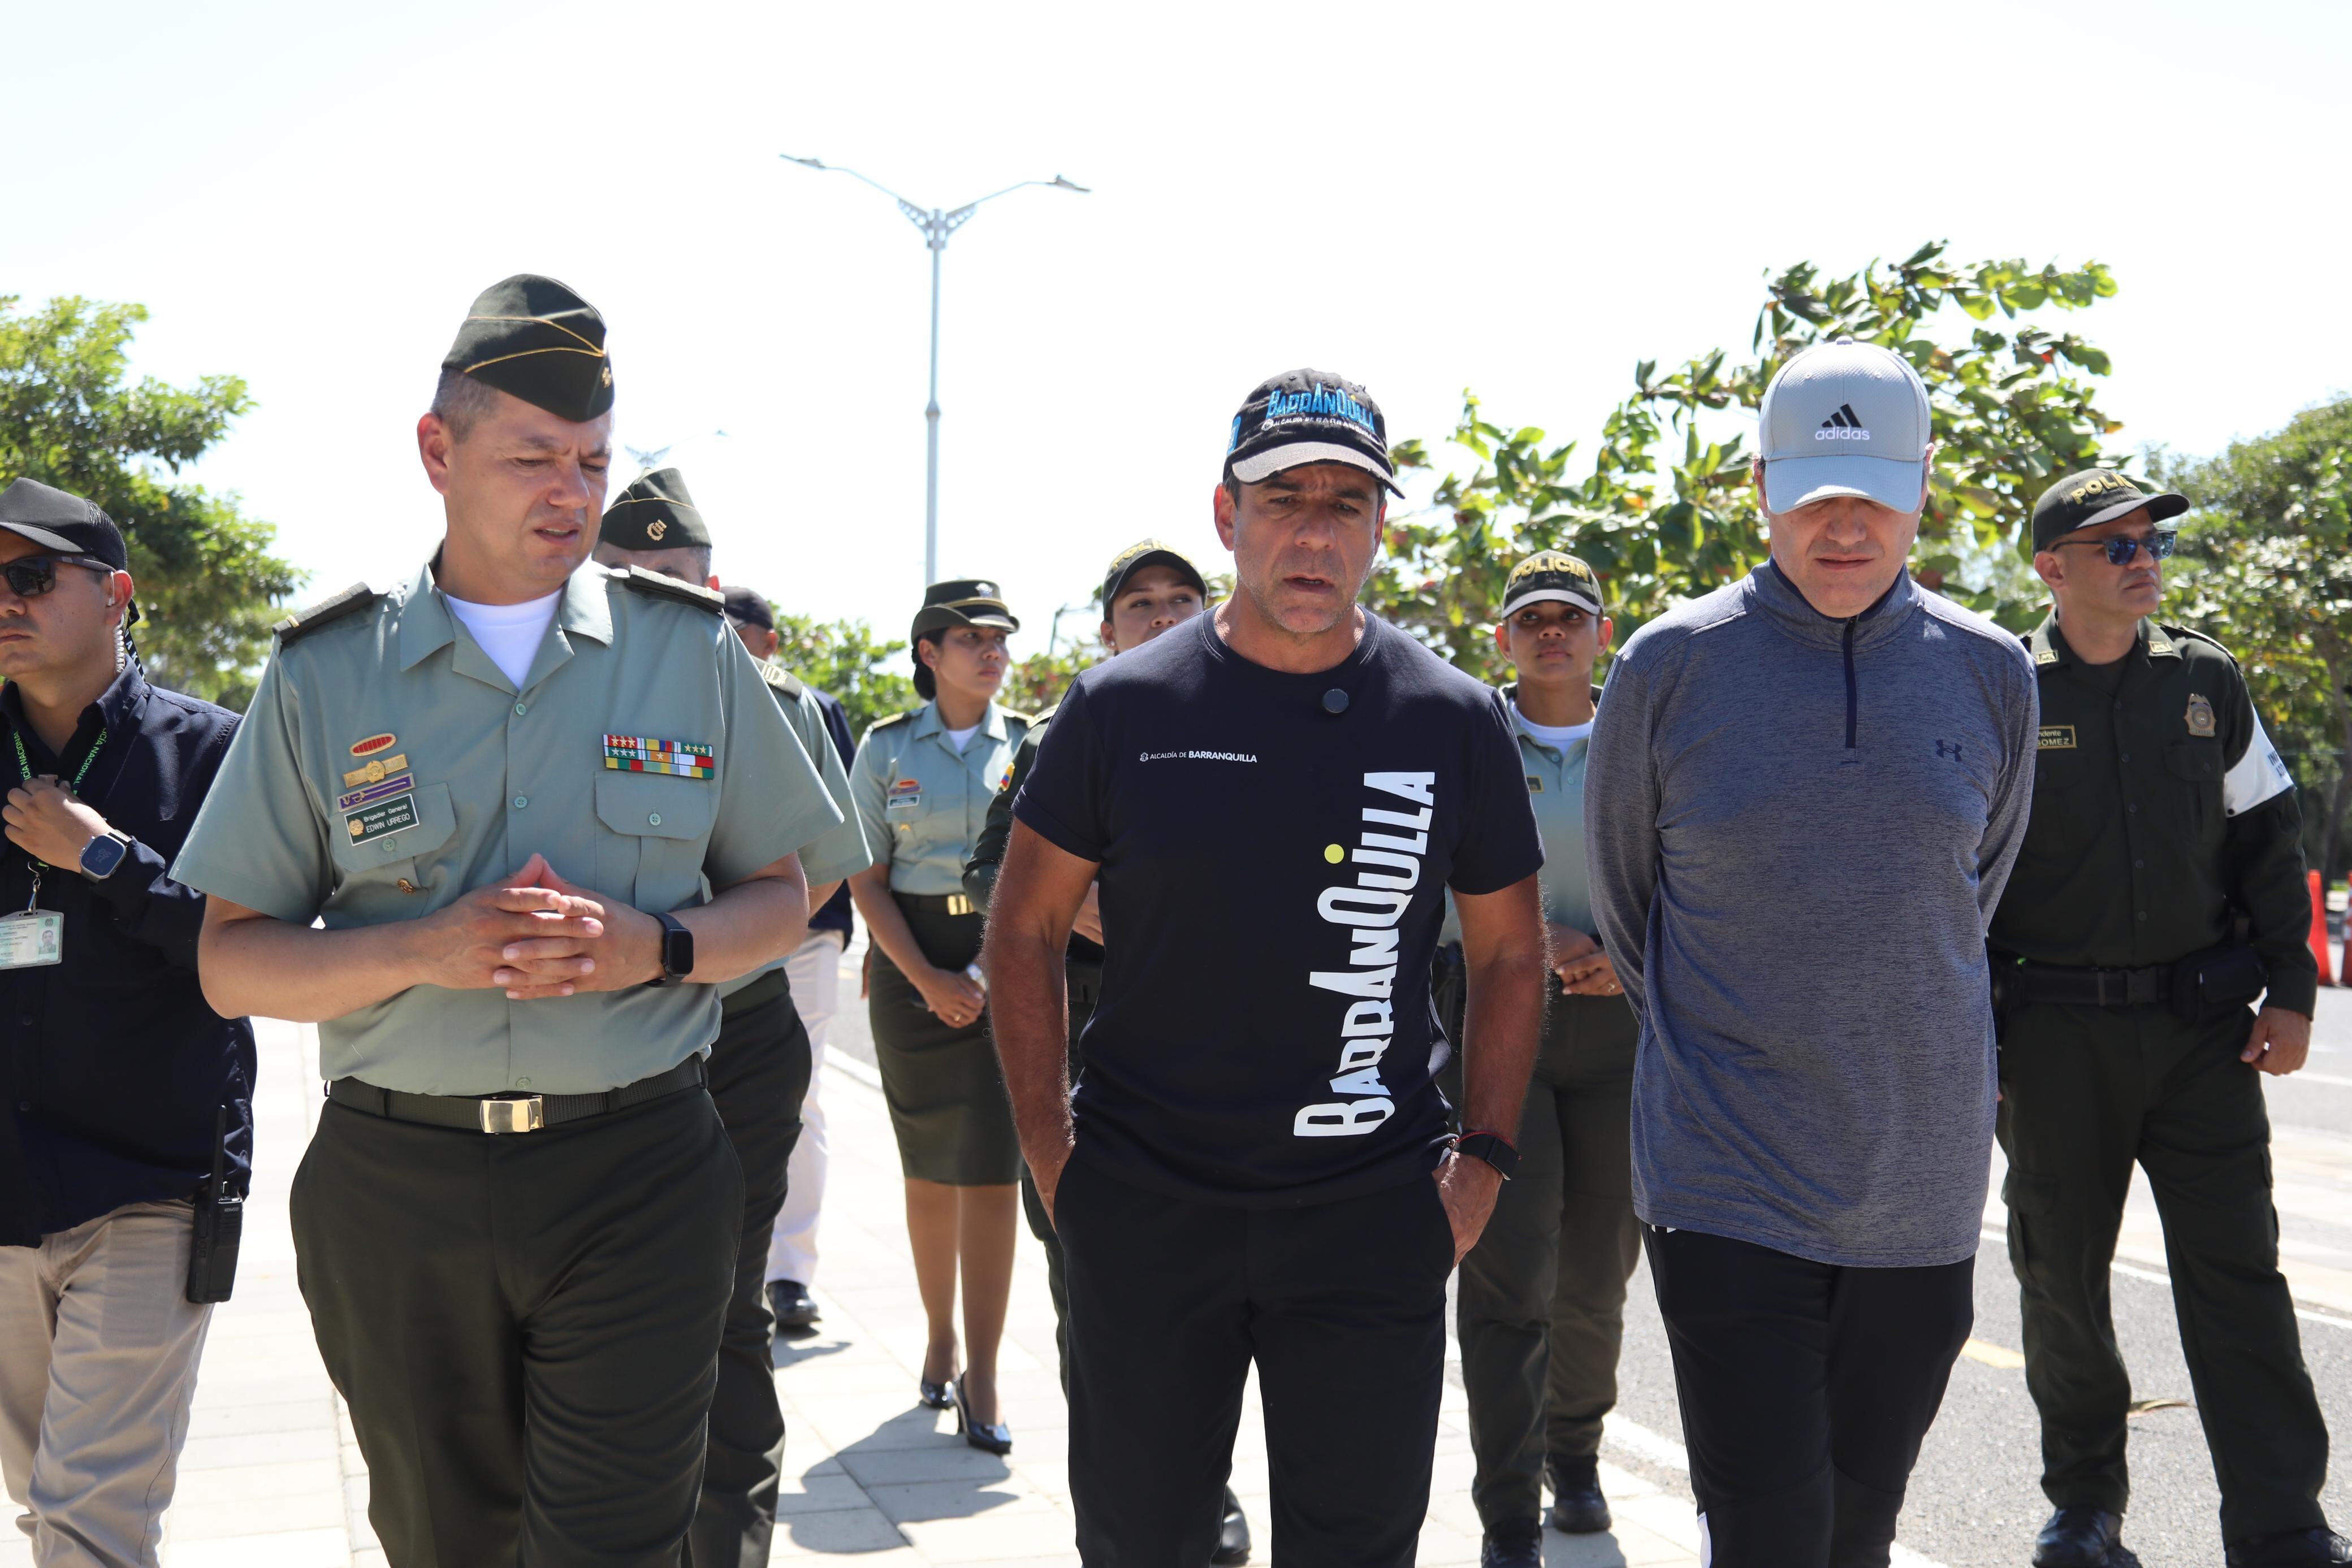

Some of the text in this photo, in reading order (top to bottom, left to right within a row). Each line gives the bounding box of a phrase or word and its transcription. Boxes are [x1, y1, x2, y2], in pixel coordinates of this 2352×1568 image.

[1266, 382, 1376, 433] BARRANQUILLA
[1815, 426, 1870, 440] adidas
[1511, 557, 1589, 584] POLICIA
[73, 746, 100, 785] NACIONAL
[1149, 751, 1177, 760] ALCALDÍA
[1188, 751, 1257, 763] BARRANQUILLA
[363, 803, 408, 822] Brigadier General
[366, 813, 410, 833] EDWIN URREGO
[1294, 772, 1435, 1136] BARRANQUILLA
